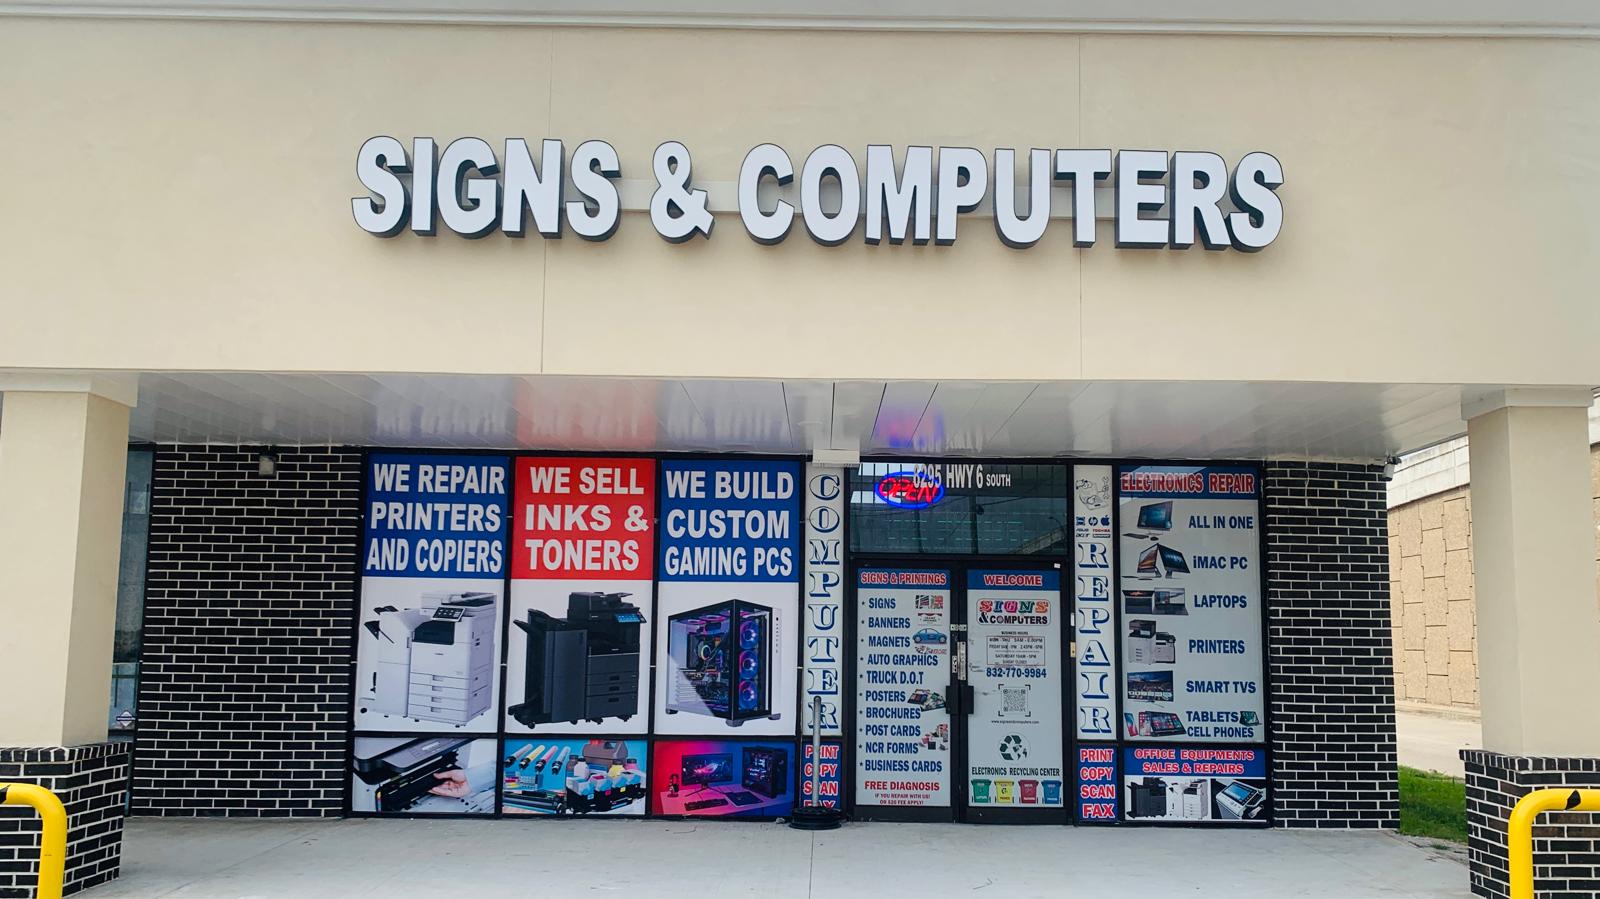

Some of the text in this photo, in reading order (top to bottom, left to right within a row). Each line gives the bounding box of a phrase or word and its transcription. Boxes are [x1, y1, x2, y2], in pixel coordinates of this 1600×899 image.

[351, 135, 1285, 252] SIGNS & COMPUTERS
[373, 463, 505, 494] WE REPAIR
[529, 466, 645, 496] WE SELL
[912, 463, 1012, 490] 8295 HWY 6 SOUTH
[1120, 472, 1255, 494] ELECTRONICS REPAIR
[665, 470, 794, 500] WE BUILD
[878, 476, 940, 503] OPEN
[370, 501, 501, 532] PRINTERS
[525, 503, 649, 532] INKS &
[666, 508, 790, 539] CUSTOM
[1188, 515, 1254, 530] ALL IN ONE
[366, 537, 502, 573] AND COPIERS
[525, 538, 640, 572] TONERS
[664, 546, 793, 577] GAMING PCS
[1193, 555, 1248, 570] iMAC PC
[860, 572, 947, 586] SIGNS & PRINTINGS
[983, 574, 1043, 586] WELCOME
[868, 597, 896, 610] SIGNS
[979, 600, 1049, 613] SIGNS
[1194, 594, 1248, 609] LAPTOPS
[868, 616, 911, 629] BANNERS
[979, 611, 1048, 625] & COMPUTERS
[868, 635, 911, 648] MAGNETS
[1077, 541, 1112, 734] REPAIR
[1188, 639, 1246, 654] PRINTERS
[867, 653, 939, 667] AUTO GRAPHICS
[866, 670, 897, 684] TRUCK
[986, 668, 1047, 678] 832-770-9984
[1186, 680, 1257, 694] SMART TVS
[865, 690, 906, 703] POSTERS
[865, 706, 921, 720] BROCHURES
[1186, 710, 1239, 723] TABLETS
[865, 724, 921, 738] POST CARDS
[1187, 726, 1254, 738] CELL PHONES
[805, 745, 839, 760] PINT
[865, 741, 919, 755] NCR FORMS
[1080, 748, 1114, 762] PRINT
[1135, 748, 1255, 761] OFFICE EQUIPMENTS
[804, 762, 838, 778] CPY
[864, 759, 943, 773] BUSINESS CARDS
[971, 767, 1060, 777] ELECTRONICS RECYCLING CENTER
[1079, 766, 1113, 781] COPY
[1142, 762, 1245, 774] SALES & REPAIRS
[803, 781, 839, 796] SAN
[864, 780, 940, 791] FREE DIAGNOSIS
[1080, 784, 1116, 799] SCAN
[1082, 803, 1116, 819] FAX
